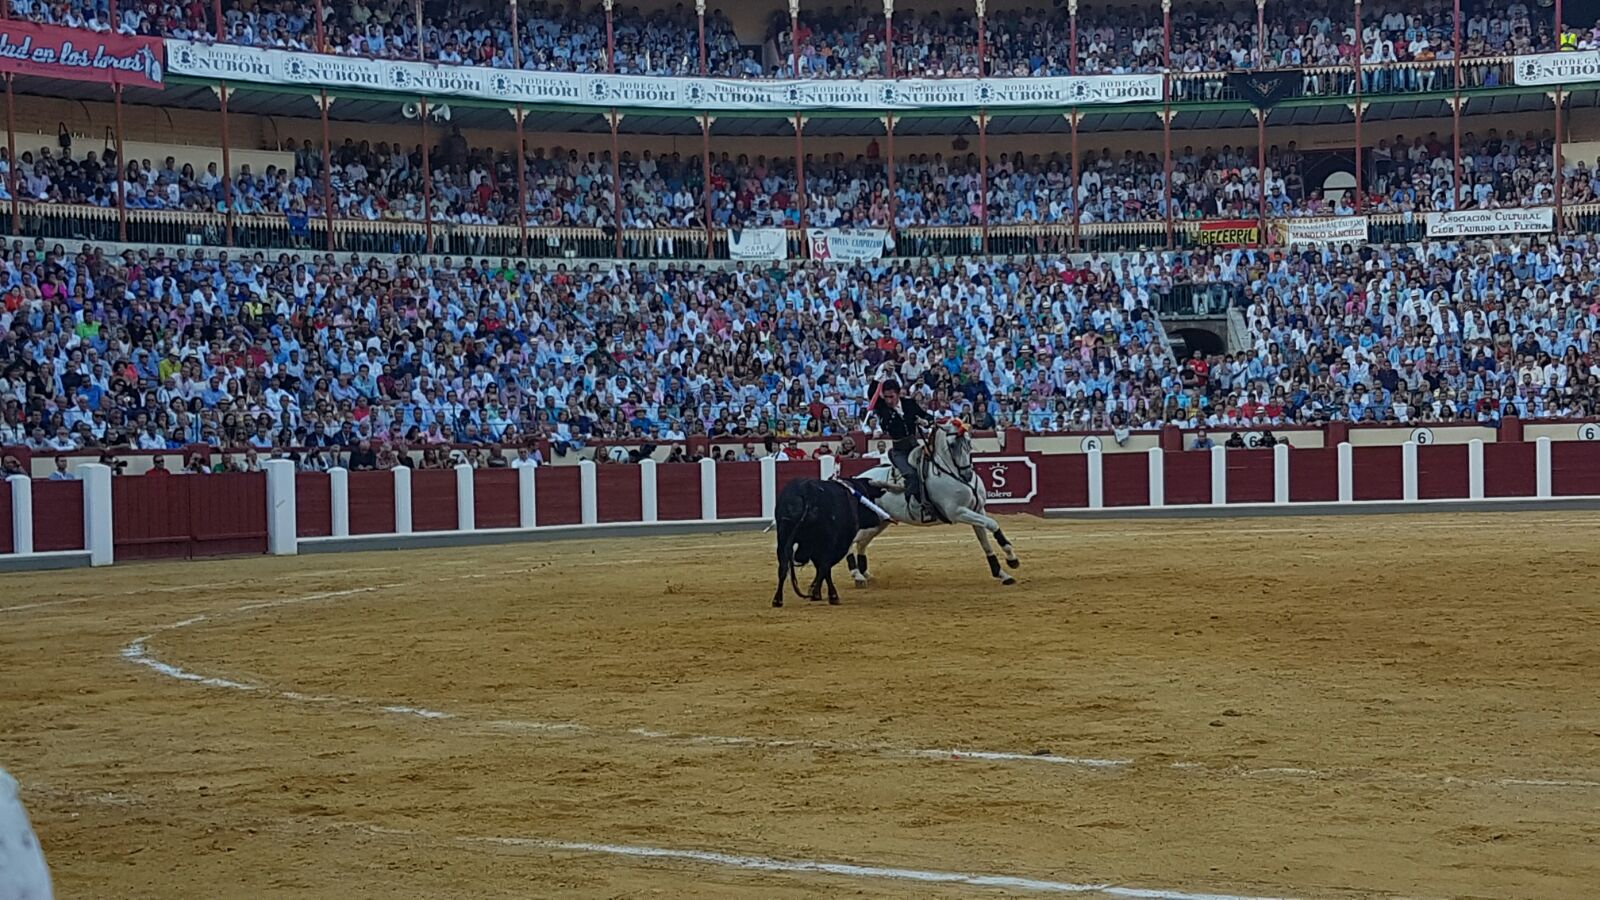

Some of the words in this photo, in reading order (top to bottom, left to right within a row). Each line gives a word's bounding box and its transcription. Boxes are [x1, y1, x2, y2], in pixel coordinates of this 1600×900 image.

[31, 47, 57, 63] en
[59, 41, 91, 67] los
[208, 51, 261, 61] BODEGAS
[199, 58, 271, 74] NUBORI
[317, 62, 369, 71] BODEGAS
[308, 69, 379, 84] NUBORI
[421, 70, 471, 79] BODEGAS
[412, 77, 480, 90] NUBORI
[520, 77, 570, 86] BODEGAS
[619, 81, 667, 90] BODEGAS
[1004, 83, 1052, 91] BODEGAS
[1100, 80, 1149, 89] BODEGAS
[512, 84, 579, 97] NUBORI
[611, 88, 676, 101] NUBORI
[996, 90, 1060, 101] NUBORI
[1091, 86, 1157, 99] NUBORI
[706, 92, 772, 103] NUBORI
[800, 93, 869, 103] NUBORI
[901, 92, 965, 102] NUBORI
[1292, 231, 1326, 239] MANOLO
[1417, 432, 1426, 444] 6
[1586, 427, 1595, 440] 6
[1087, 440, 1096, 450] 6
[1249, 436, 1258, 447] 6
[614, 450, 623, 462] 7
[992, 468, 1006, 488] S
